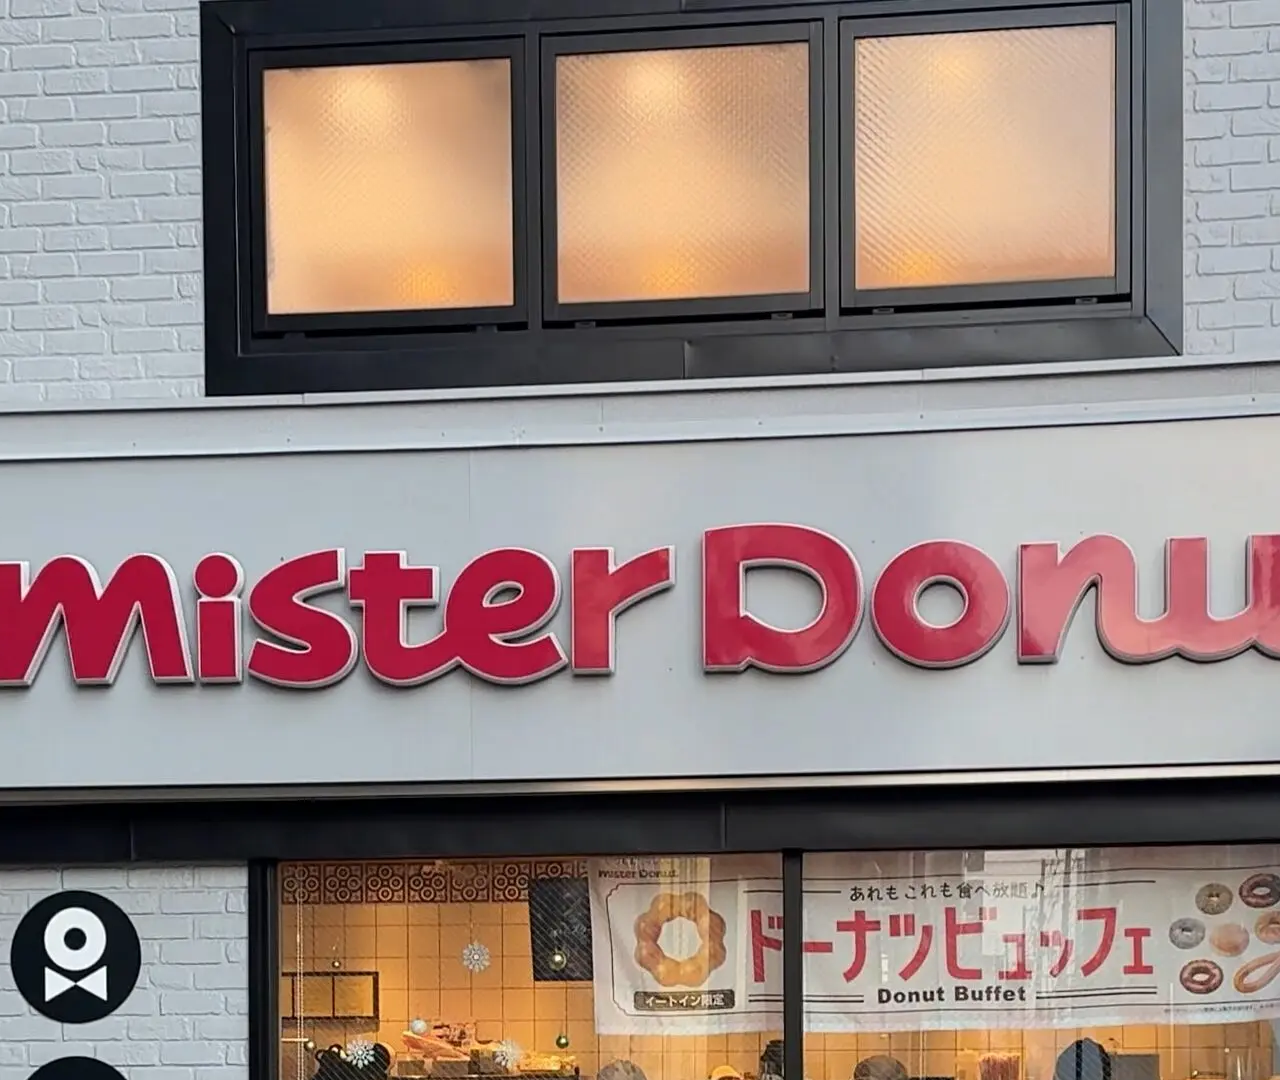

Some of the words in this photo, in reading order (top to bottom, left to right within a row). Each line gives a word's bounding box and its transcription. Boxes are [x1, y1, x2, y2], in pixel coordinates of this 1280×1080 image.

[750, 906, 1154, 984] ドーナツビュッフェ
[877, 987, 945, 1004] Donut
[954, 985, 1027, 1002] Buffet
